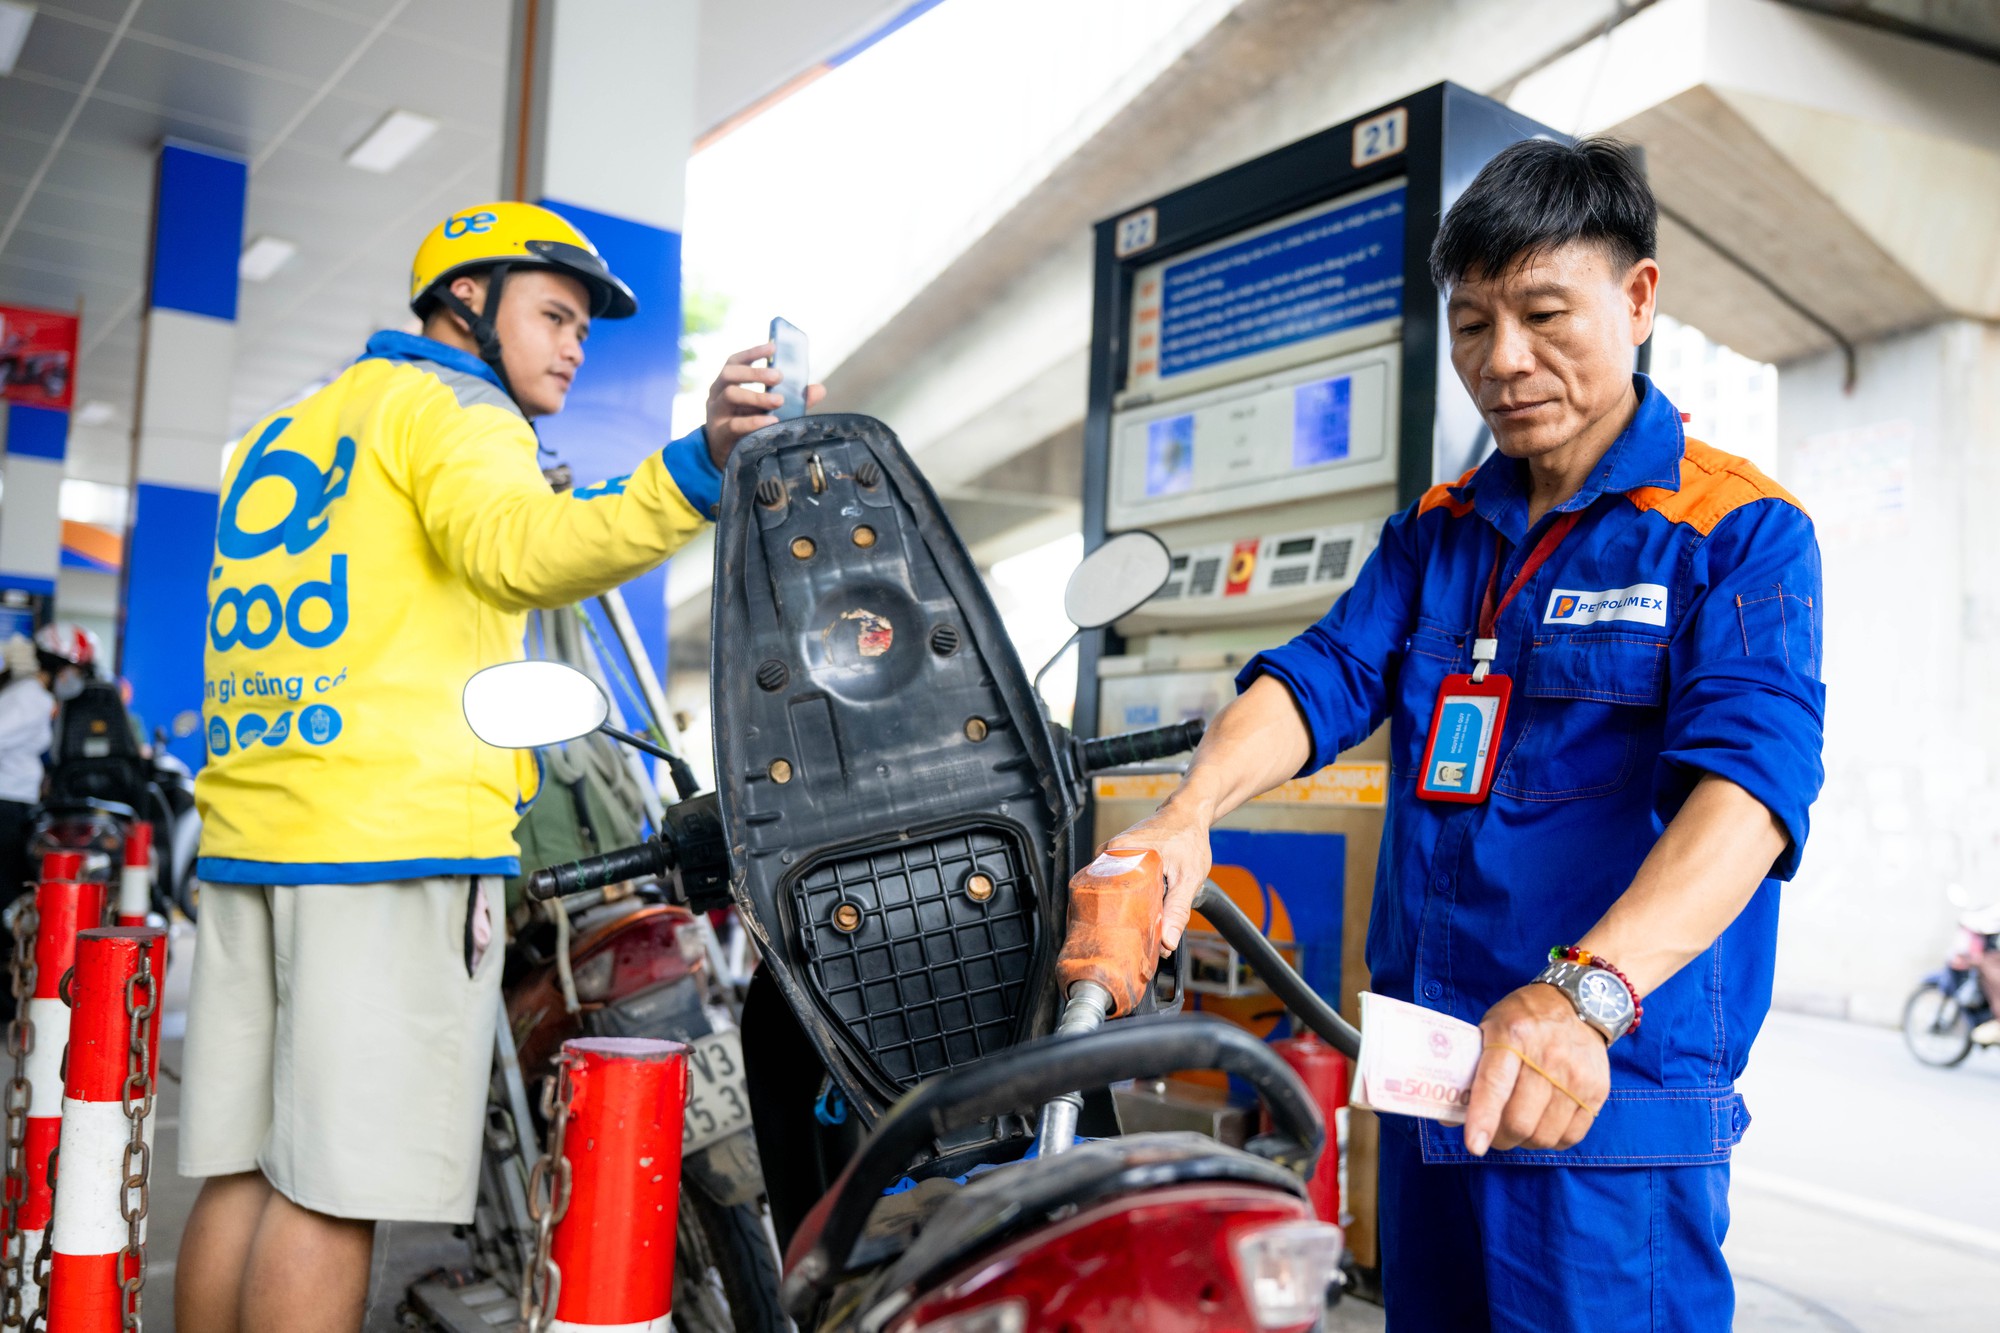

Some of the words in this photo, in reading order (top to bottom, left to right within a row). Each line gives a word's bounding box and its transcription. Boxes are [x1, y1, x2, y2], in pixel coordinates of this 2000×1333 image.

[1364, 118, 1395, 157] 21
[444, 211, 498, 240] be
[217, 416, 357, 561] be
[209, 553, 350, 653] ood
[1578, 596, 1663, 613] PETROLIMEX
[218, 671, 236, 704] gì
[242, 671, 304, 702] cũng
